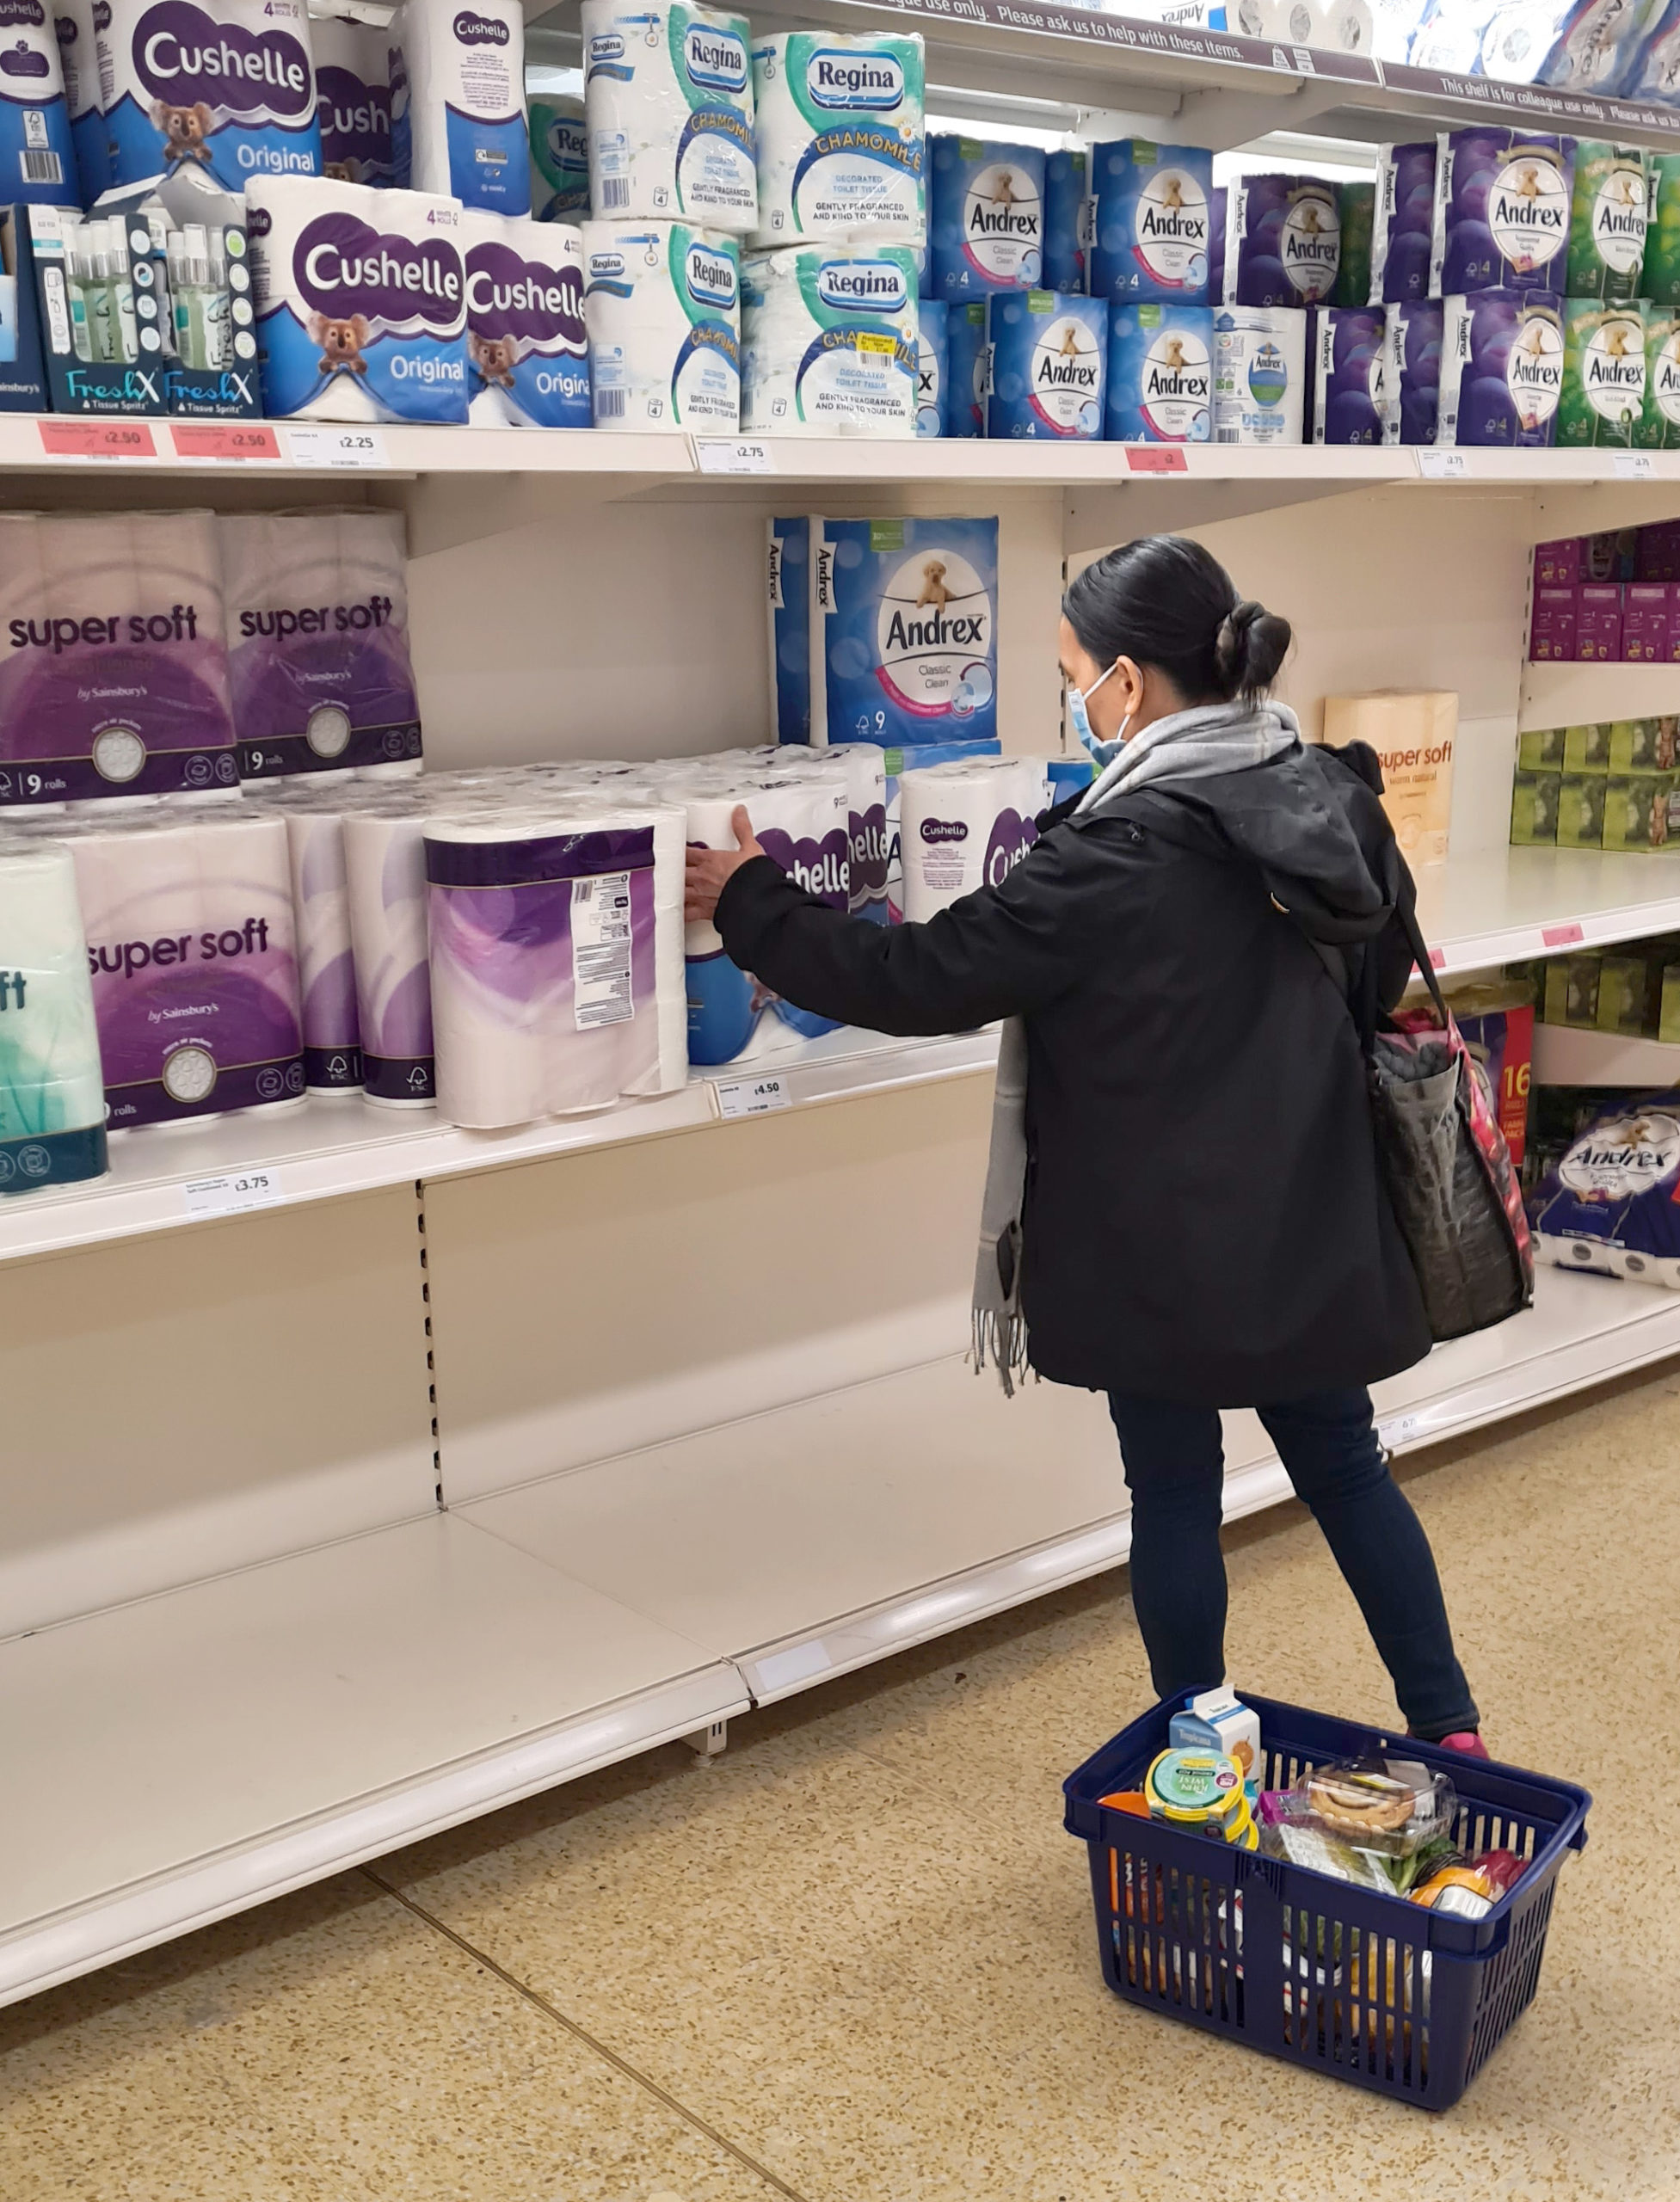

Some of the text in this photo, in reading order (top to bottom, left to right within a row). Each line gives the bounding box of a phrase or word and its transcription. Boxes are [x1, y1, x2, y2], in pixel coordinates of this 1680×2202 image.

[0, 2, 42, 18] ushelle
[263, 2, 274, 15] 4
[1162, 3, 1204, 25] Andrex
[457, 20, 508, 40] Cushelle
[953, 1, 990, 22] only.
[996, 5, 1044, 27] Please
[1047, 15, 1071, 31] ask
[1074, 20, 1089, 34] us
[1091, 21, 1105, 37] to
[1103, 22, 1136, 45] help
[1138, 29, 1168, 46] with
[1170, 34, 1203, 53] these
[1204, 43, 1244, 60] items.
[592, 40, 622, 54] Regina
[692, 36, 742, 71] Regina
[145, 32, 305, 91] Cushelle
[818, 64, 895, 91] Regina
[1440, 77, 1463, 94] This
[1465, 83, 1489, 99] shelf
[1500, 87, 1516, 102] for
[1517, 91, 1563, 114] colleague
[1564, 101, 1581, 113] use
[1609, 105, 1640, 121] Please
[1641, 110, 1657, 124] ask
[690, 112, 754, 151] CHAMOMIL
[237, 145, 315, 173] Original
[833, 184, 858, 194] TOILET
[835, 175, 883, 185] DECORATED
[1441, 156, 1452, 200] Andrex
[657, 194, 663, 205] 4
[1383, 169, 1395, 211] Andrex
[427, 209, 436, 225] 4
[813, 212, 830, 221] AND
[832, 212, 852, 221] KIND
[892, 212, 909, 222] SKIN
[815, 202, 846, 212] GENTLY
[1234, 194, 1244, 235] Andrex
[1495, 194, 1563, 229] Andrex
[970, 203, 1037, 235] Andrex
[1086, 199, 1097, 242] Andrex
[1142, 206, 1205, 239] Andrex
[564, 239, 570, 252] 4
[993, 245, 1017, 255] Classic
[1162, 249, 1185, 259] Classic
[1287, 235, 1337, 260] Andrex
[305, 243, 459, 301] Cushelle
[592, 256, 622, 270] Regina
[692, 255, 733, 290] Regina
[828, 271, 900, 296] Regina
[961, 271, 969, 285] 4
[1130, 273, 1139, 287] 4
[467, 272, 586, 323] Cushelle
[1394, 325, 1404, 366] Andrex
[1458, 315, 1469, 358] Andrex
[822, 330, 917, 371] CHAILE
[1322, 329, 1332, 369] Andrex
[390, 355, 464, 385] Original
[1038, 355, 1097, 386] Andrex
[1256, 357, 1282, 370] Andrex
[1513, 355, 1560, 384] Andrex
[1589, 356, 1645, 384] Andrex
[0, 384, 40, 395] insbury's
[65, 371, 160, 403] FreshX
[163, 371, 253, 404] FreshX
[536, 372, 590, 397] Origina
[835, 378, 861, 388] TOILET
[1148, 366, 1209, 396] Andrex
[92, 400, 146, 412] Tissue Spritz
[188, 403, 240, 415] Tissue Spritz
[776, 405, 782, 414] 4
[815, 402, 834, 411] AND
[889, 408, 906, 417] SKIN
[819, 392, 902, 407] GENTLY FRAGRANCED
[1165, 407, 1187, 417] Classic
[105, 433, 140, 444] £2.50
[1026, 422, 1037, 434] 4
[232, 434, 265, 446] £2.50
[340, 437, 373, 448] £2.25
[737, 447, 764, 458] £2.75
[769, 544, 779, 600] Andrex
[818, 549, 832, 607] Andrex
[240, 595, 392, 642] super soft
[9, 605, 197, 655] super soft
[886, 610, 984, 650] Andrex
[305, 670, 352, 683] Sainsbury's
[919, 665, 952, 676] Classic
[77, 686, 148, 701] by Sainsbury's
[925, 678, 949, 689] Clean
[875, 710, 886, 729] 9
[251, 751, 284, 770] 9 rolls
[1378, 741, 1452, 772] super soft
[28, 775, 66, 796] 9 rolls
[834, 797, 840, 809] 9
[922, 824, 966, 837] Cushelle
[786, 852, 850, 895] helle
[88, 917, 269, 979] super soft
[148, 1002, 219, 1024] by Sainsbury's
[754, 1082, 779, 1096] £4.50
[1504, 1061, 1531, 1099] 16
[114, 1104, 137, 1116] rolls
[1569, 1146, 1671, 1168] Andrex
[235, 1176, 269, 1192] £3.75
